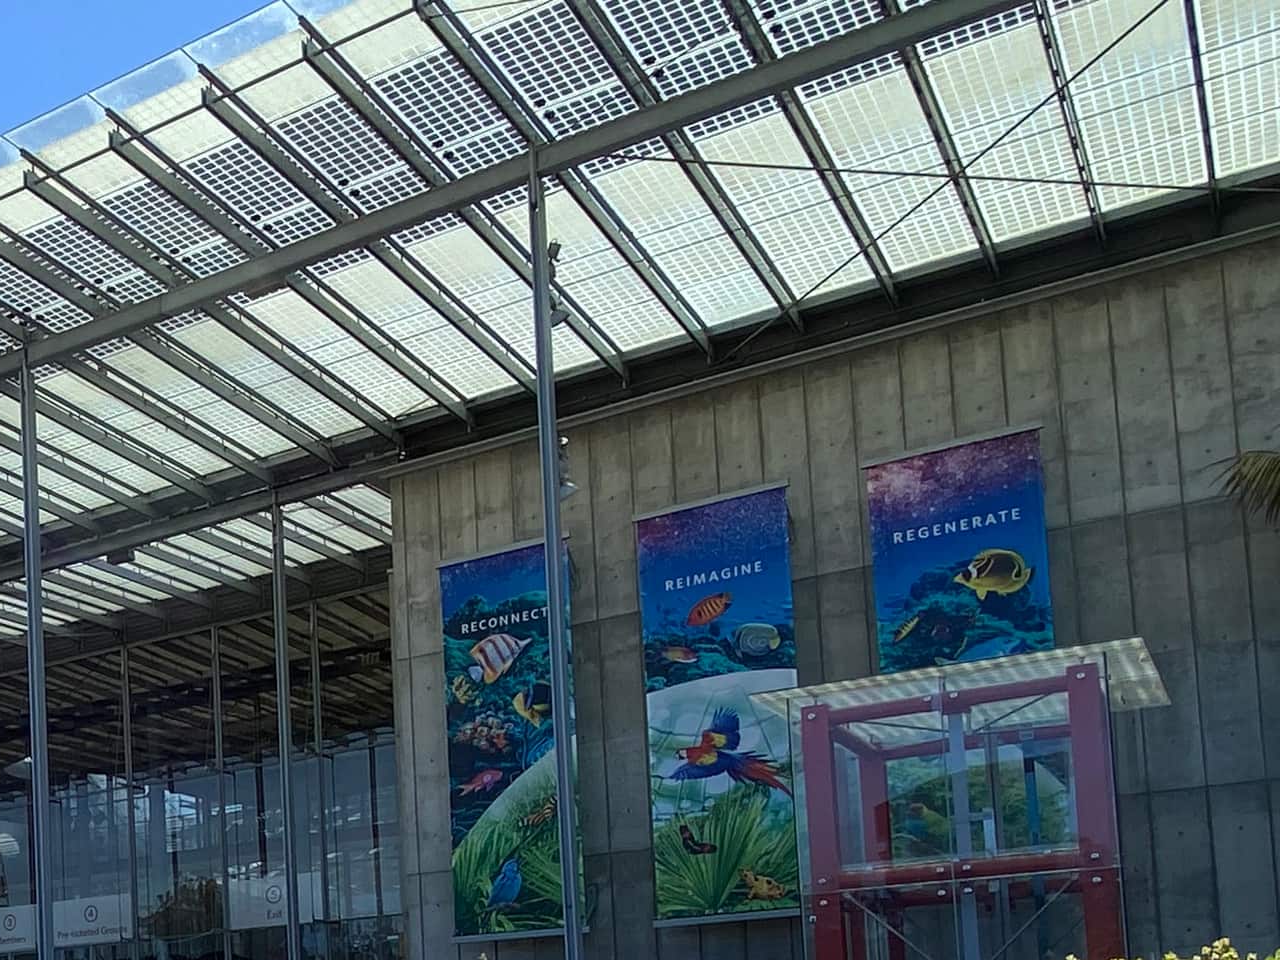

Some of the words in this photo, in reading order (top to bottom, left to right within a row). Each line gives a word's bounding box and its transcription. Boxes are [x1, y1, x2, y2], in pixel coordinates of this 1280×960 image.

[893, 508, 1021, 544] REGENERATE
[665, 560, 763, 592] REIMAGINE
[461, 606, 548, 634] RECONNECT
